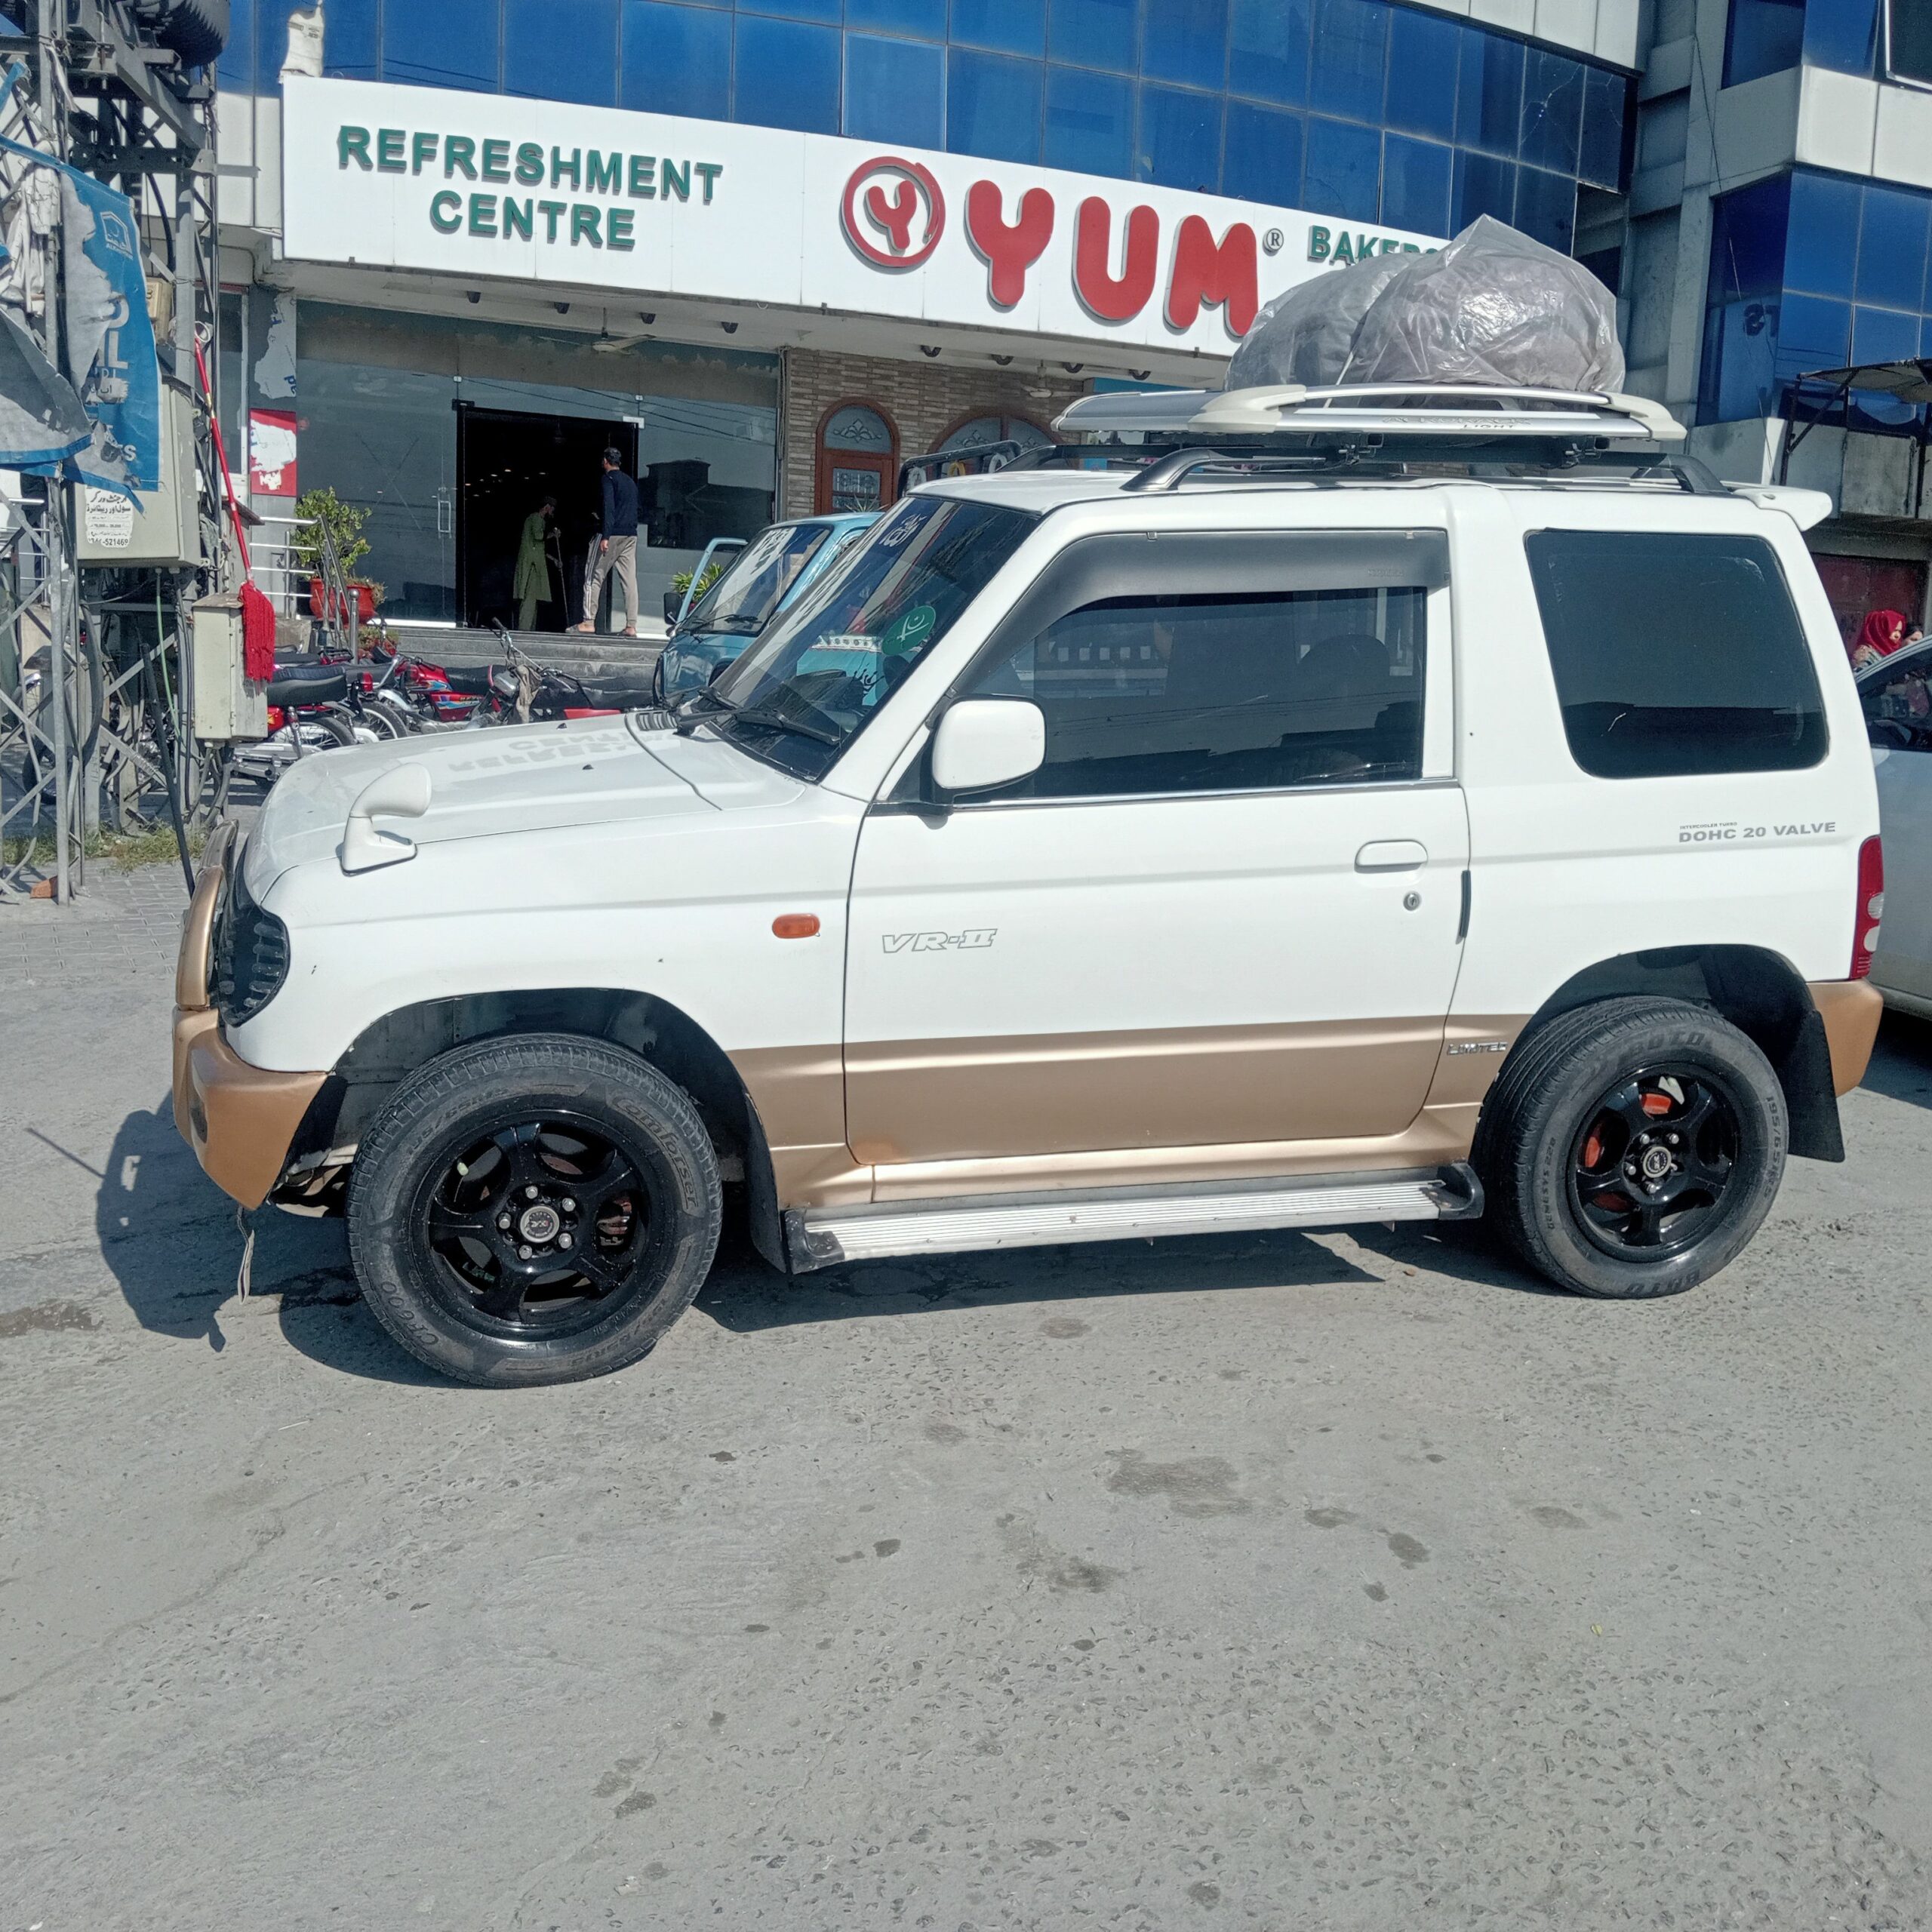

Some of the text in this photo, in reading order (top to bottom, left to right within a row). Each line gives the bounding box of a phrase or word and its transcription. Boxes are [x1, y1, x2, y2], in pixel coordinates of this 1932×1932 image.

[337, 125, 723, 205] REFRESHMENT
[429, 189, 635, 251] CENTRE
[964, 179, 1259, 337] YUM
[1678, 821, 1836, 843] DOHC 20 VALVE
